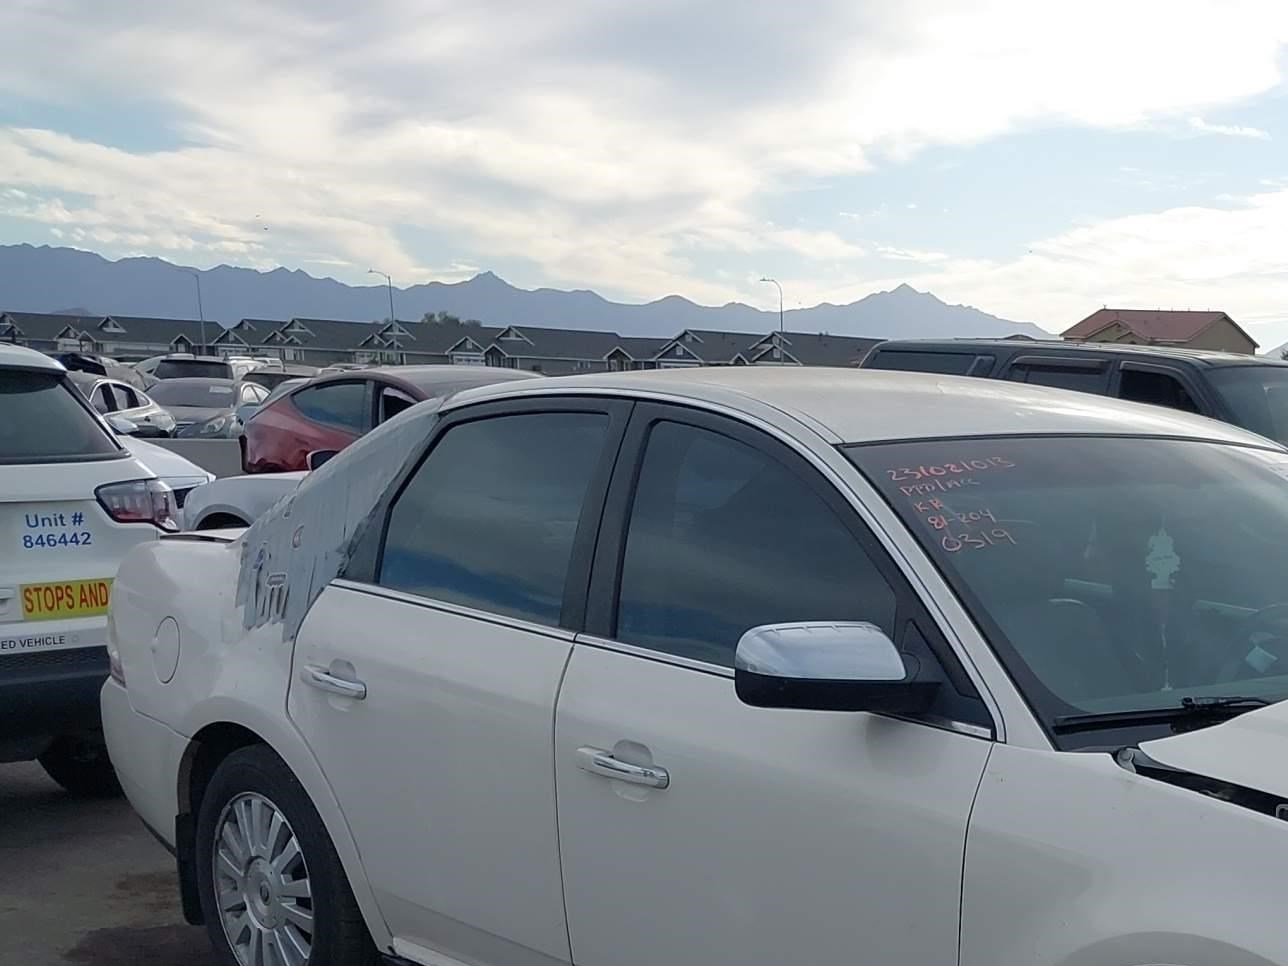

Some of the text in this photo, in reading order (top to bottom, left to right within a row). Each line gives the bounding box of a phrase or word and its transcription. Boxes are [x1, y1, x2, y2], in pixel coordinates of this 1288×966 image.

[25, 511, 85, 528] Unit #
[22, 531, 92, 549] 846442
[942, 528, 1017, 551] 0319
[22, 582, 109, 614] STOPS AND
[19, 635, 65, 649] VEHICLE
